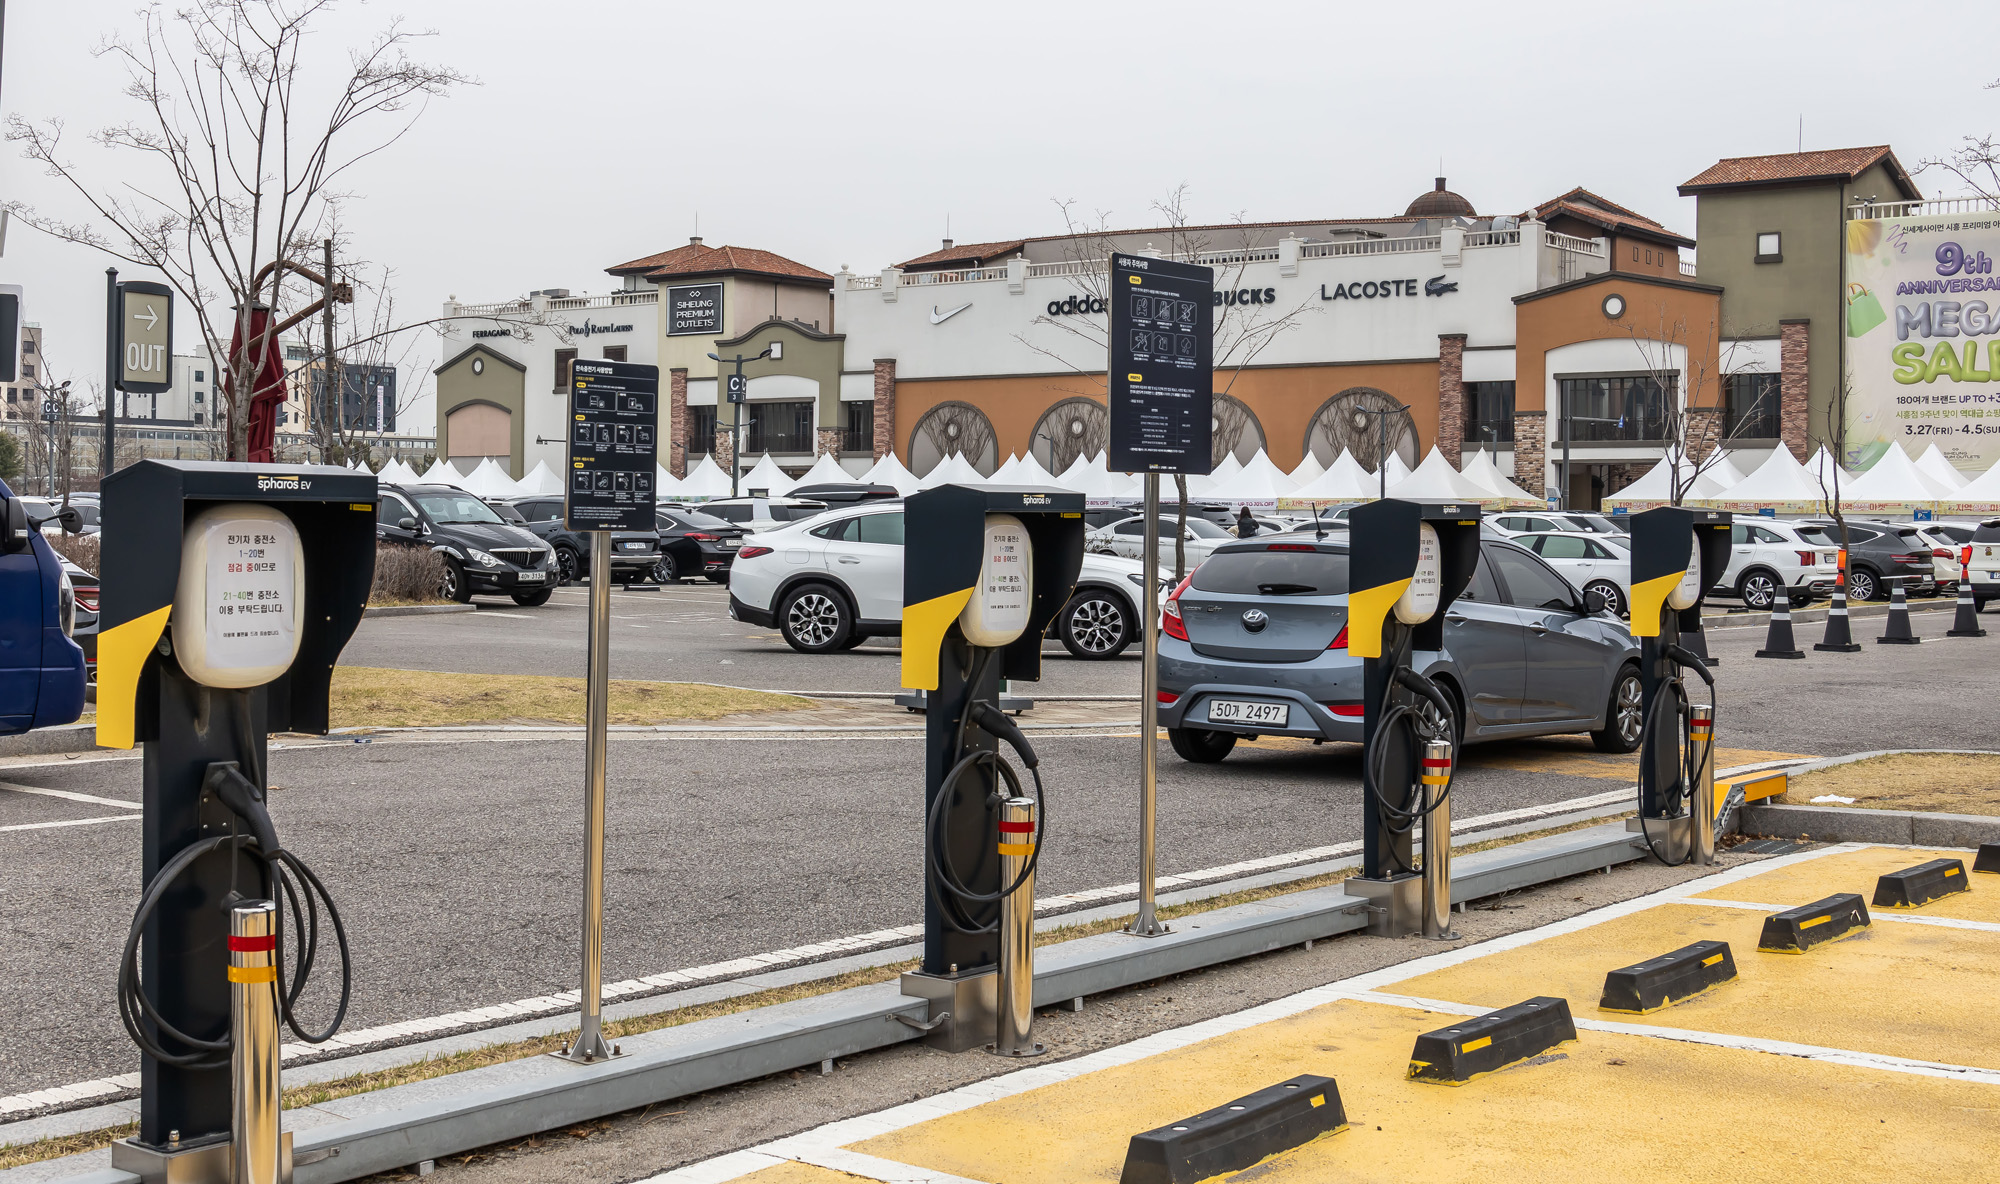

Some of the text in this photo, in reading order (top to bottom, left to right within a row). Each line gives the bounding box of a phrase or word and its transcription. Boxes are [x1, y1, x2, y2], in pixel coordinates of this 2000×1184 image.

[1902, 223, 1944, 234] 신세계사이먼
[1945, 222, 1960, 232] 시흥
[1962, 221, 1991, 230] 프리미엄
[1935, 241, 1993, 276] 9th
[1321, 279, 1417, 301] LACOSTE
[677, 299, 714, 309] SIHEUNG
[676, 309, 715, 319] PREMIUM
[676, 319, 714, 329] OUTLETS
[472, 329, 511, 338] FERRAGAMO
[126, 342, 165, 372] OUT
[730, 377, 740, 390] C
[1896, 395, 1929, 405] 180여개
[1931, 395, 1957, 405] 브랜드
[1958, 395, 1972, 404] UP
[1972, 394, 1987, 404] TO
[45, 402, 51, 413] C
[52, 402, 59, 413] C
[1896, 410, 1919, 419] 시흥점
[1920, 410, 1940, 419] 9주년
[1942, 409, 1958, 418] 맞이
[1960, 407, 1984, 418] 역대급
[1905, 424, 1953, 436] 3.27(FRI)
[257, 477, 312, 491] spharos EV
[227, 535, 276, 544] 전기차 충전소
[239, 549, 265, 558] 1-20번
[228, 562, 276, 572] 점검 중이므로
[223, 590, 280, 600] 21-40번 충전소
[219, 604, 284, 614] 이용 부탁드립니다.
[1216, 703, 1280, 721] 50가 2497
